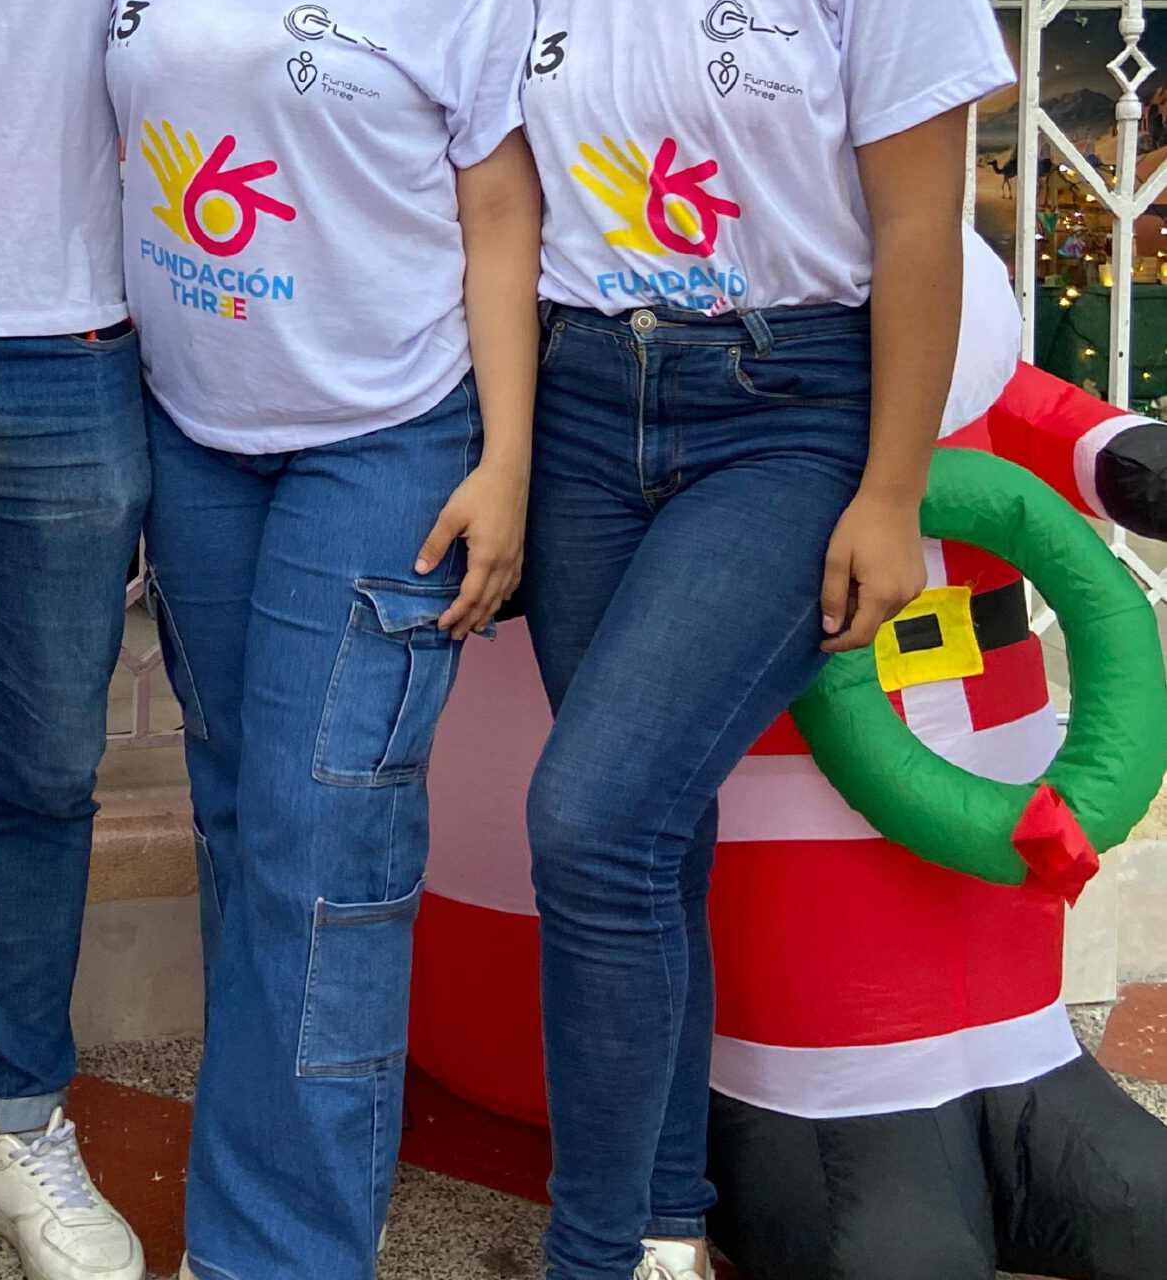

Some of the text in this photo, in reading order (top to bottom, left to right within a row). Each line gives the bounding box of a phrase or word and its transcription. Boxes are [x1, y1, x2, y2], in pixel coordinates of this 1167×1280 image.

[321, 82, 354, 102] Three
[322, 72, 380, 99] Fundación
[742, 83, 776, 102] Three
[743, 72, 804, 96] Fundación
[140, 237, 294, 300] FUNDACIÓN
[170, 277, 247, 321] THREE
